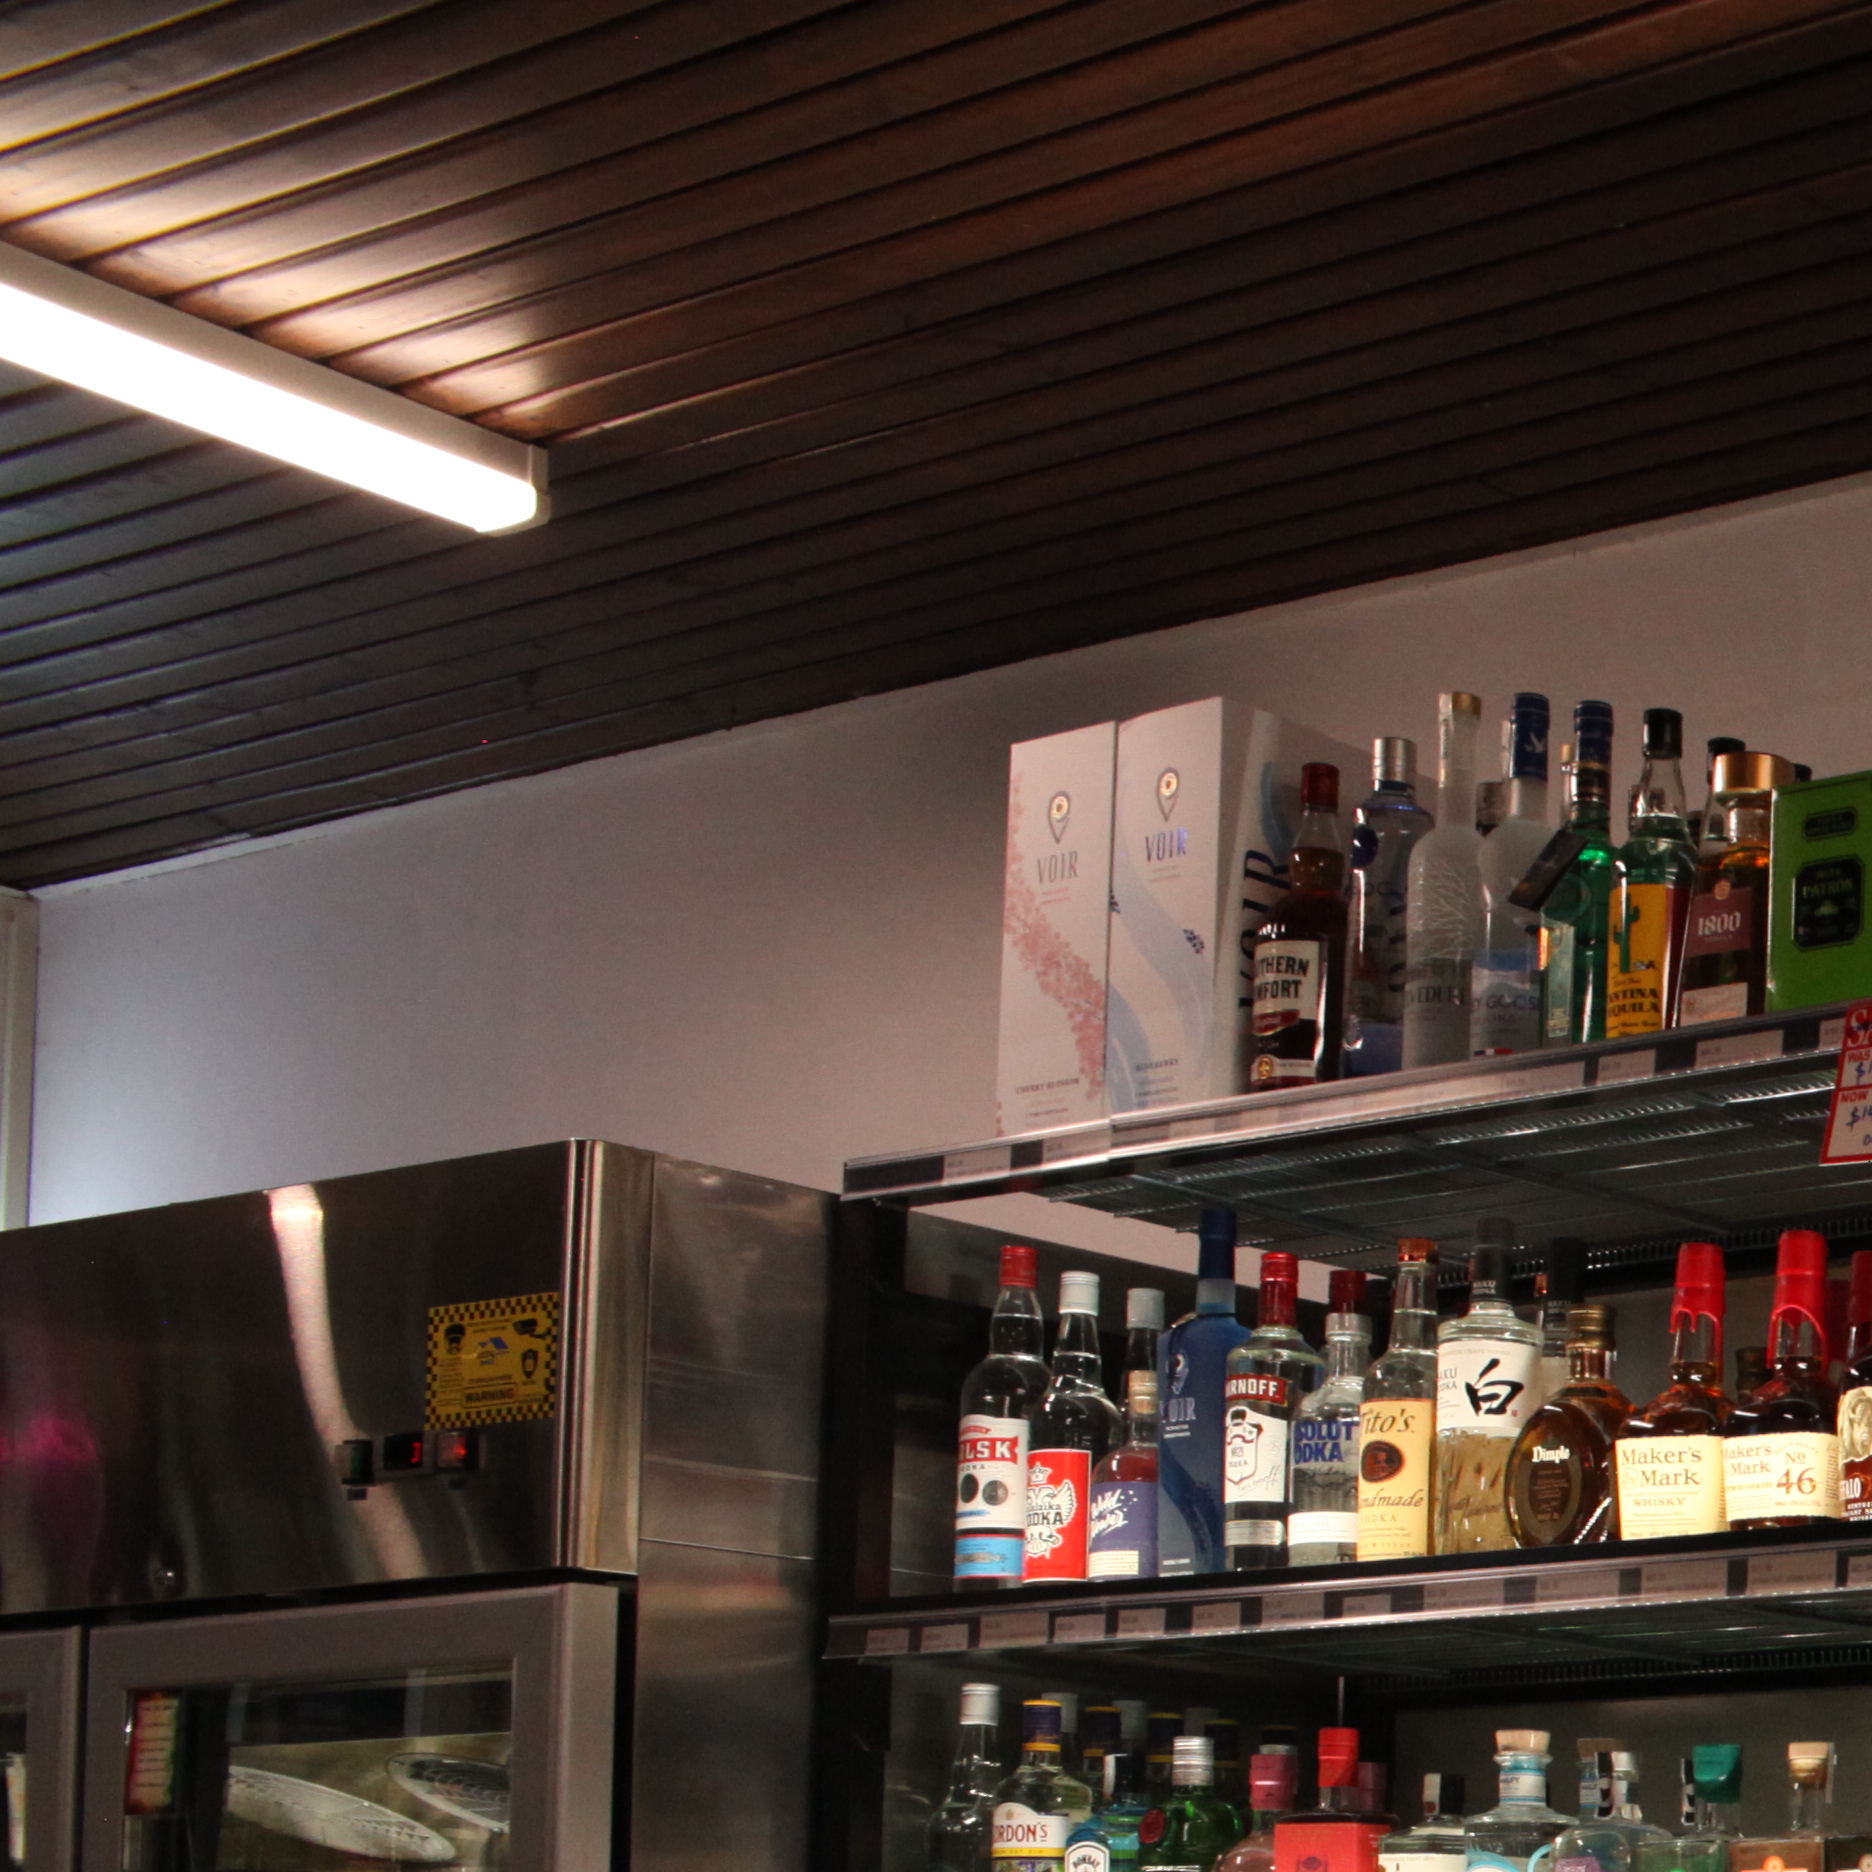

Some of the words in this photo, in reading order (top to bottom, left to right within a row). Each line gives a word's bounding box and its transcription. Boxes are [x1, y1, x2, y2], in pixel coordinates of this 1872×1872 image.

[1144, 827, 1189, 863] VOIR
[1035, 850, 1079, 886] VOIR
[1697, 910, 1741, 936] 1800
[464, 1385, 516, 1406] WARNING
[1465, 1358, 1525, 1417] 白
[1620, 1447, 1702, 1466] Maker's
[1639, 1468, 1700, 1488] Mark
[1776, 1467, 1817, 1497] 46
